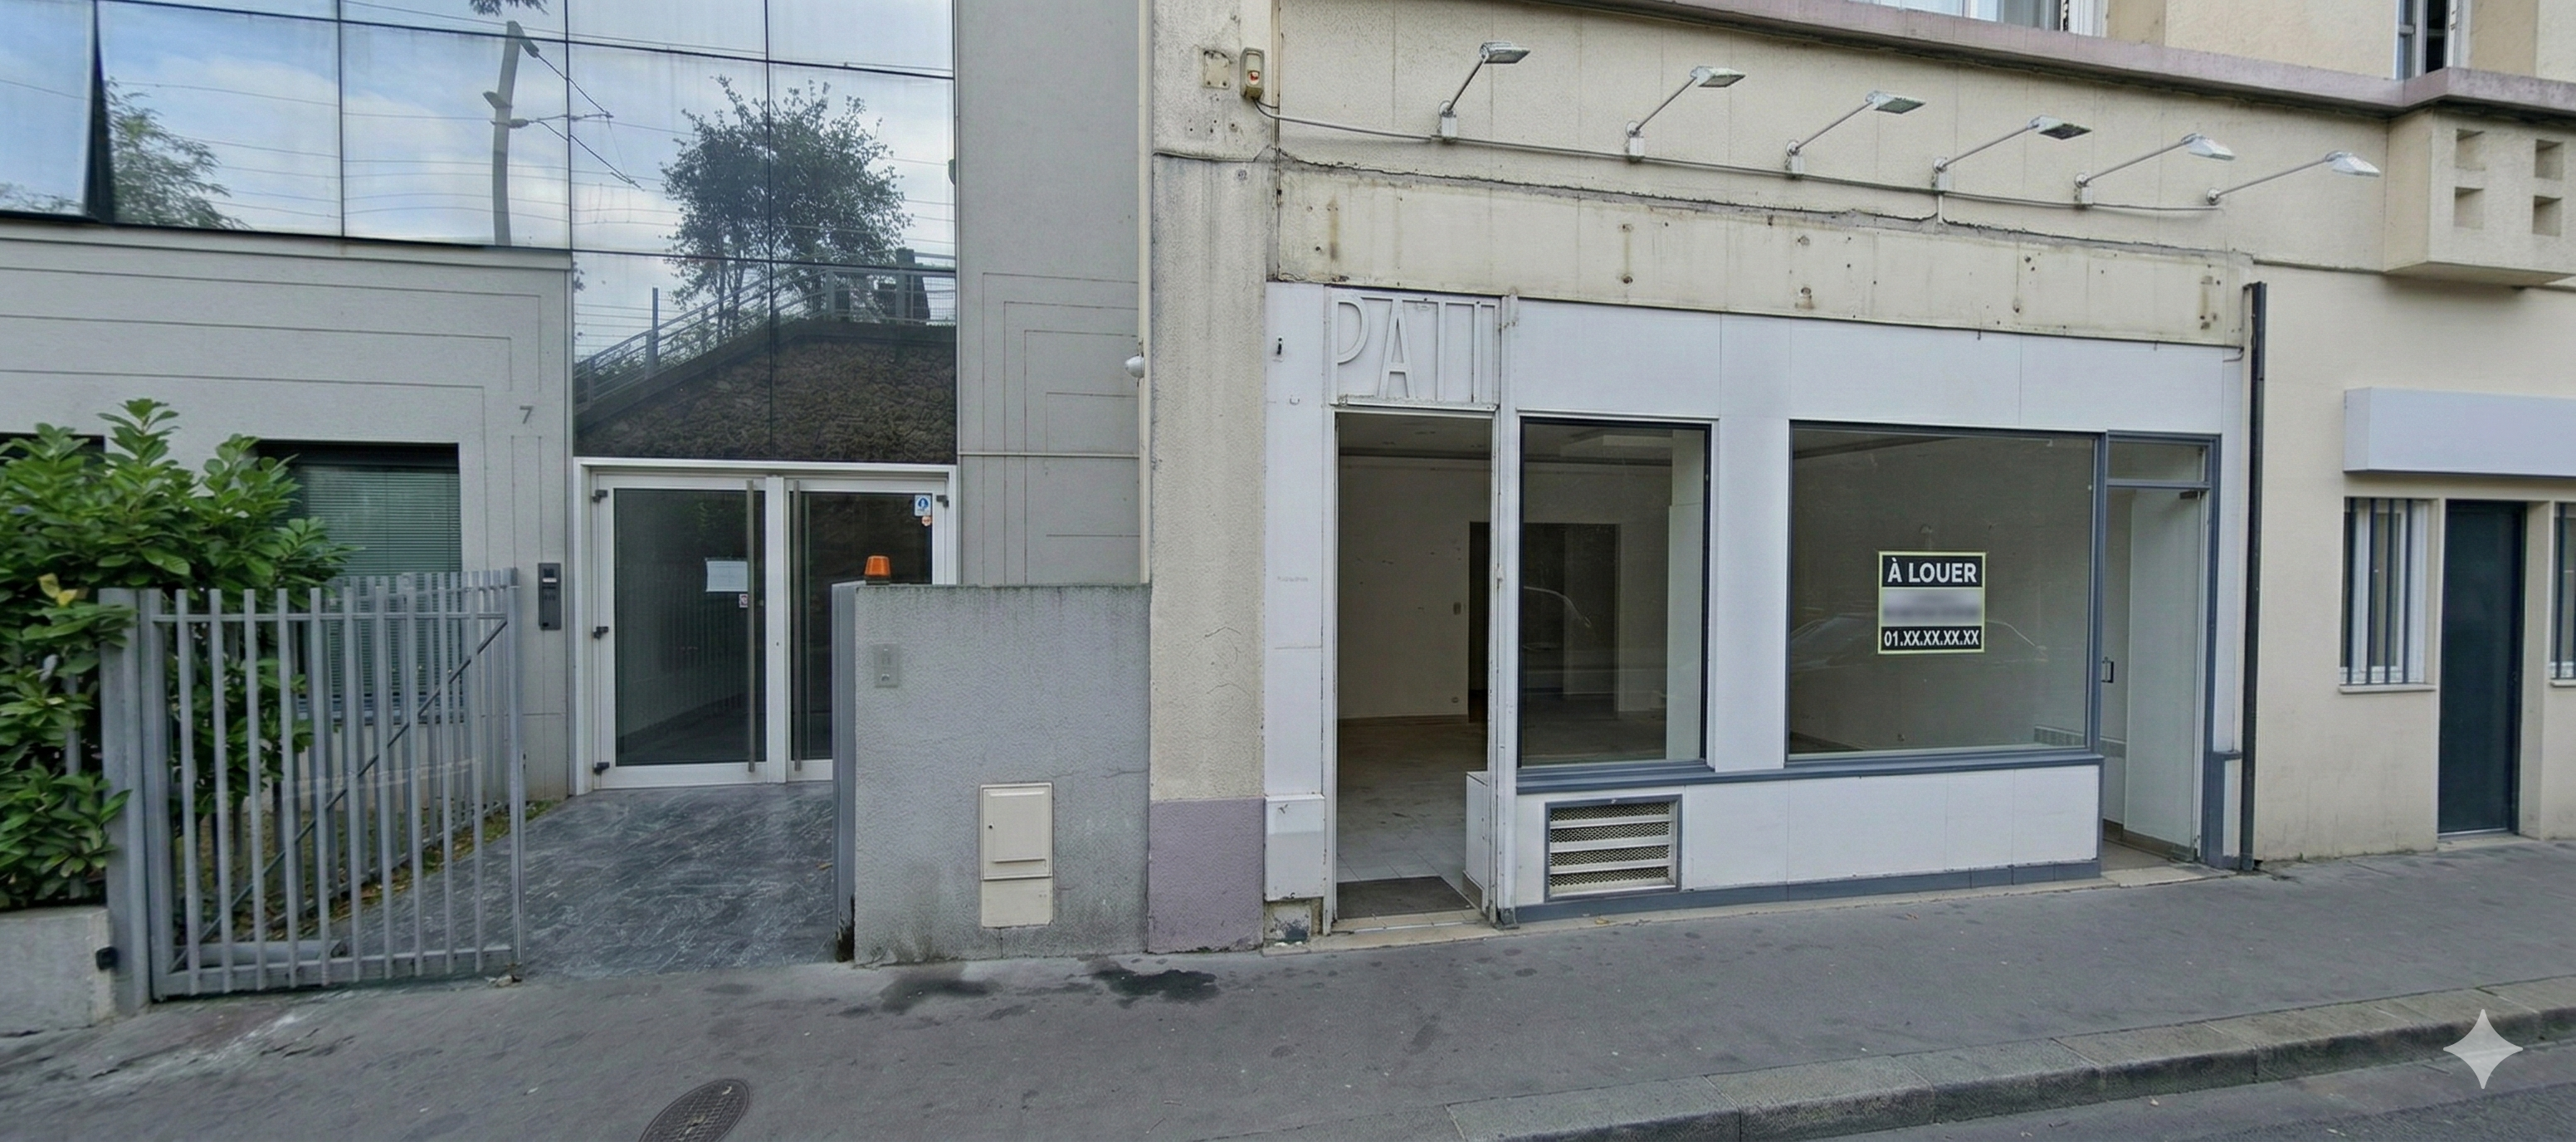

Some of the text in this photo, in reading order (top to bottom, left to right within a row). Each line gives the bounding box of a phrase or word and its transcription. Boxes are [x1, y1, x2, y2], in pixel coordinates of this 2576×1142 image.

[520, 405, 534, 424] 7
[1887, 557, 1977, 583] À LOUER
[1884, 629, 1979, 647] 01.XX.XX.XX.XX
